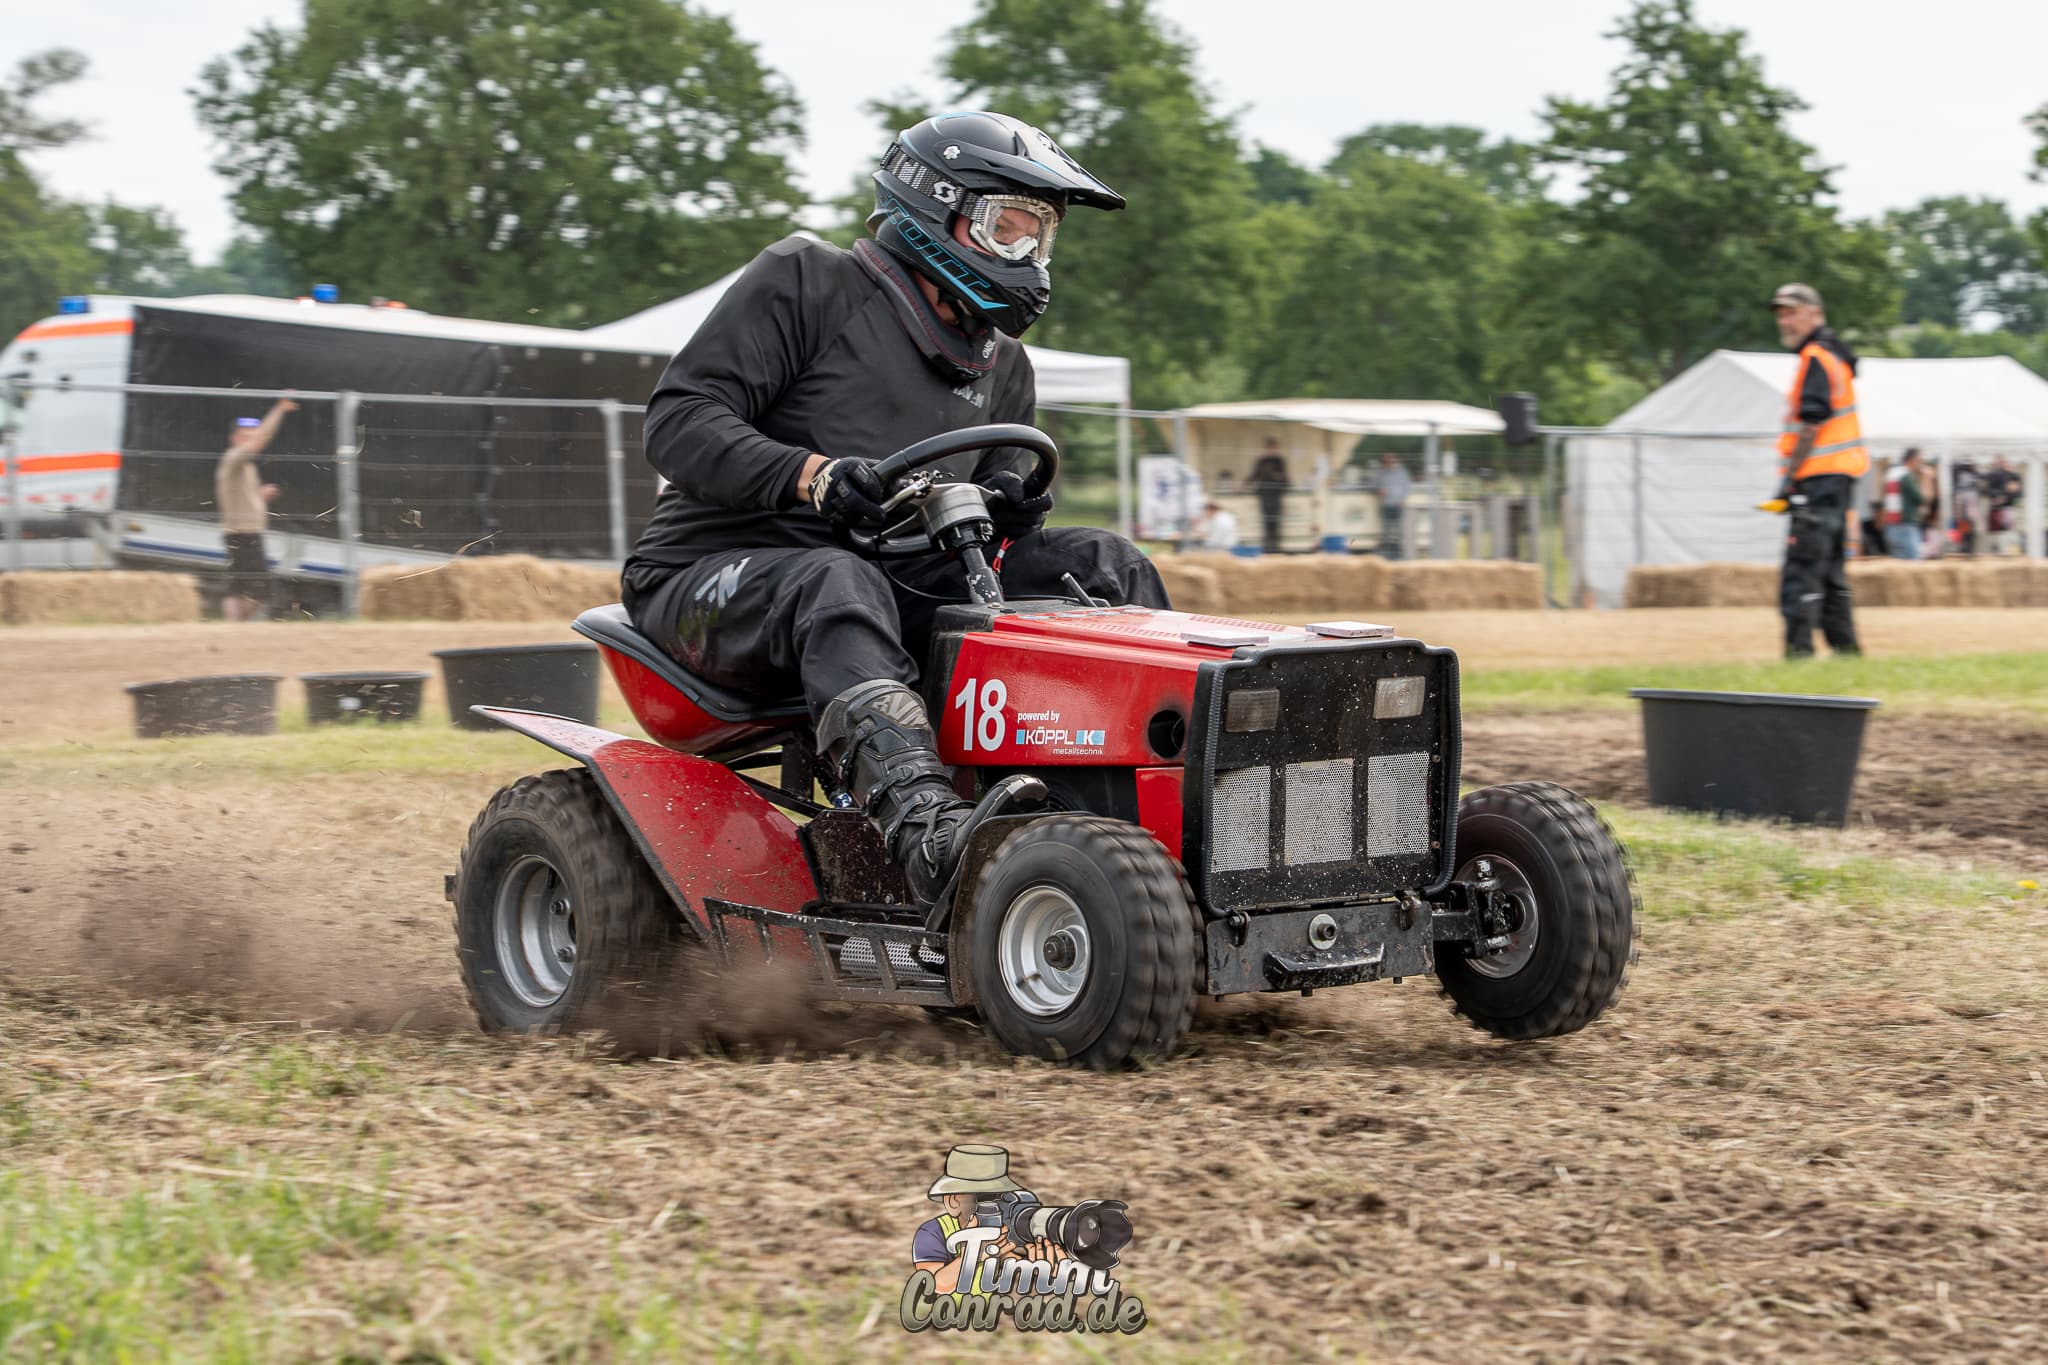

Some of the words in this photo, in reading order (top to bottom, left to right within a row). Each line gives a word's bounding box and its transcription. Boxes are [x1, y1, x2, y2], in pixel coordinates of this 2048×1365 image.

[955, 678, 1007, 752] 18
[1017, 710, 1049, 723] powered
[1051, 710, 1060, 723] by
[1025, 726, 1074, 745] KÖPPL
[1052, 746, 1103, 755] metalltechnik
